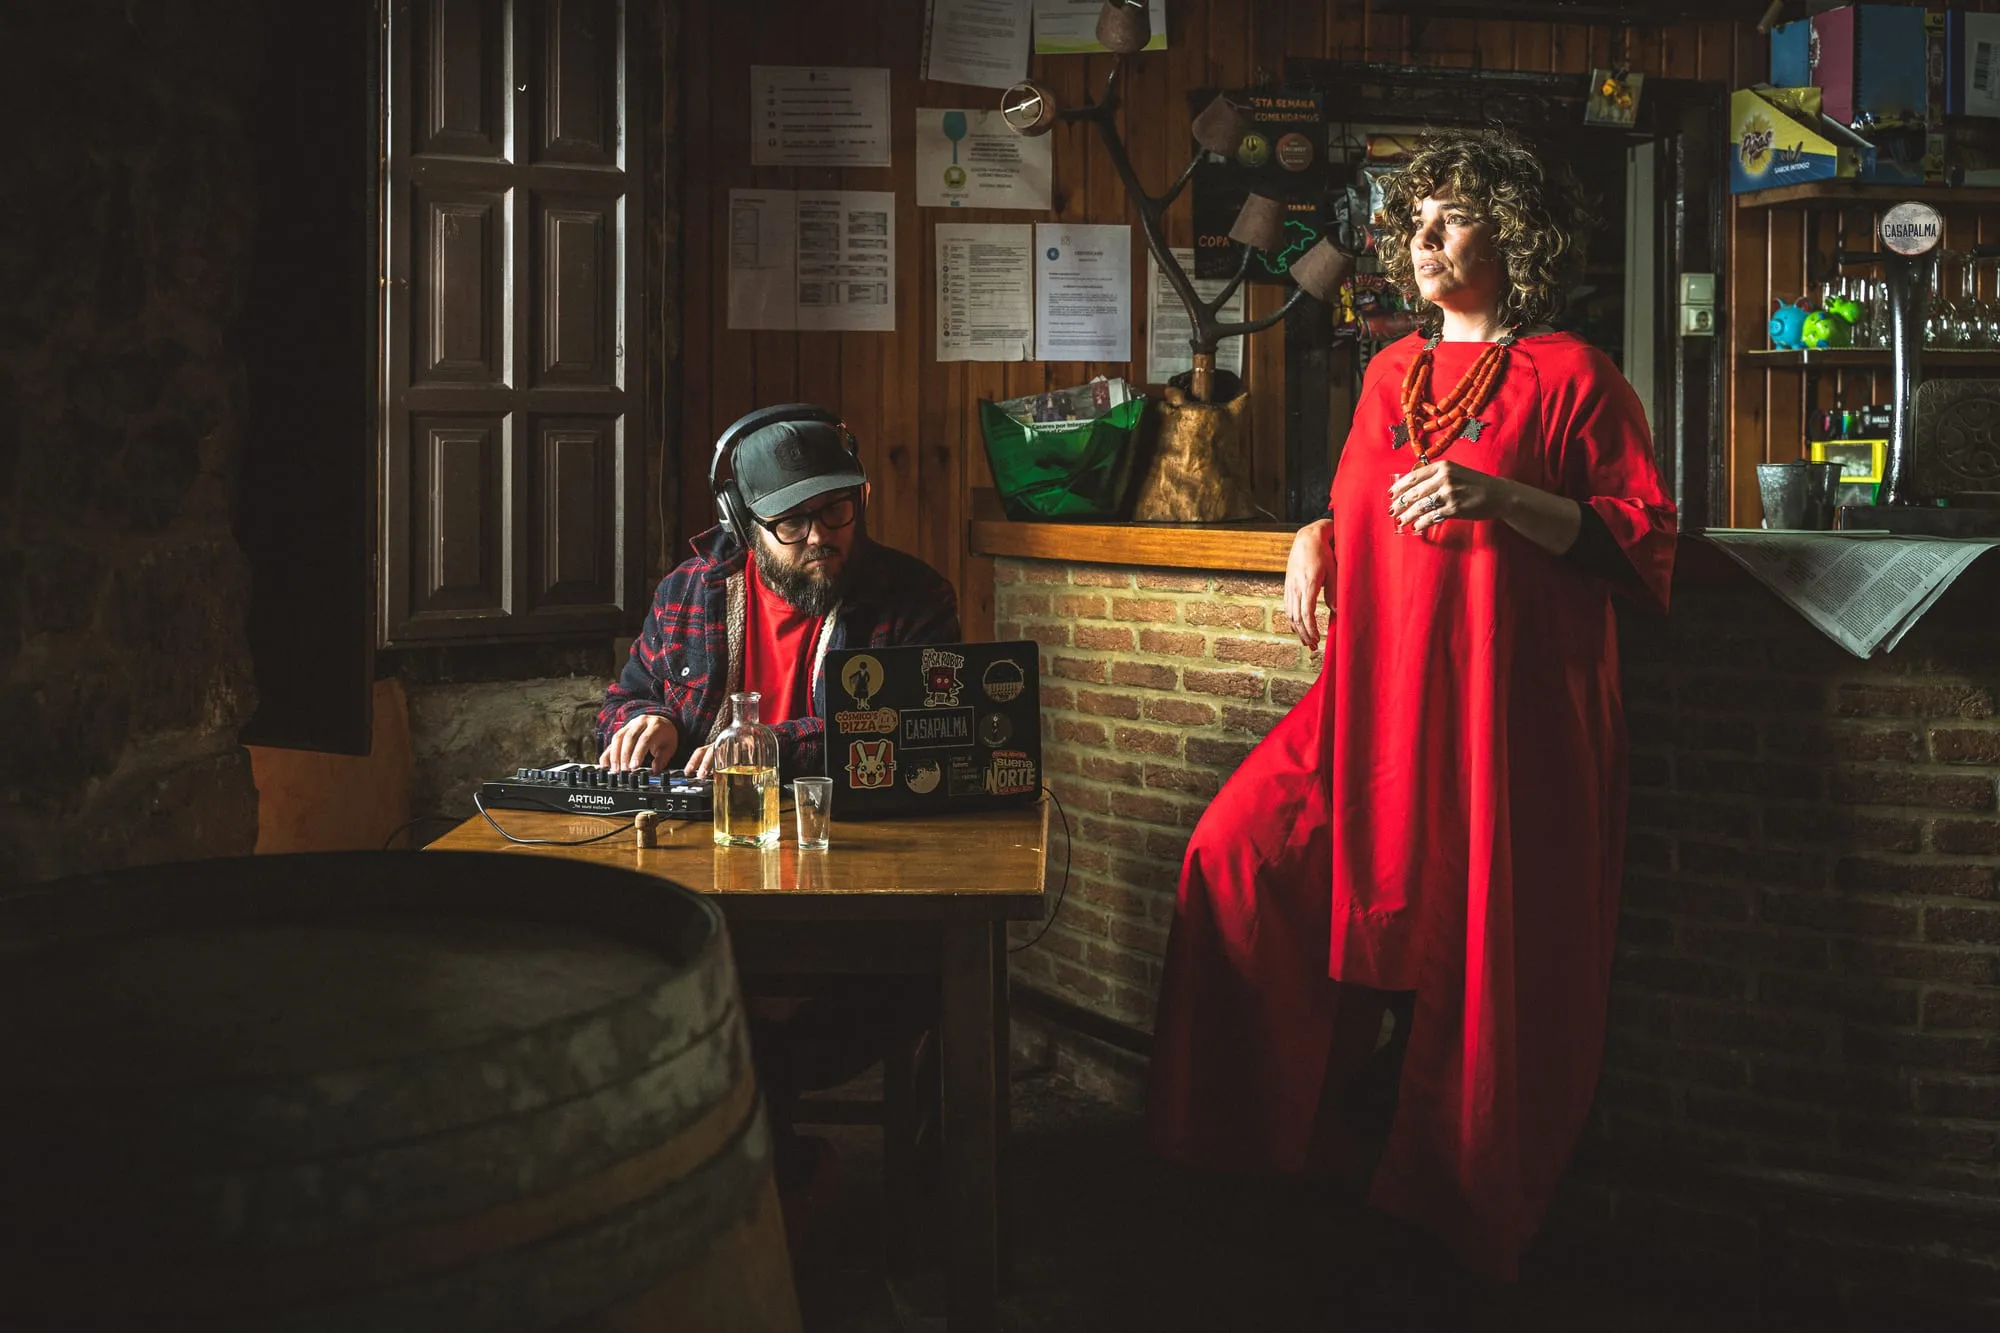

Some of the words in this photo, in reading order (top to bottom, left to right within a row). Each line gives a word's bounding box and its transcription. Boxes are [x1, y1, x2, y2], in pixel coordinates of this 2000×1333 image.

[1249, 96, 1272, 108] STA
[1884, 223, 1937, 238] CASAPALMA
[941, 651, 963, 668] ROBOT
[841, 721, 877, 732] PIZZA
[905, 715, 968, 741] CASAPALMA
[997, 758, 1033, 768] suena
[985, 761, 1036, 793] NORTE
[568, 793, 615, 806] ARTURIA
